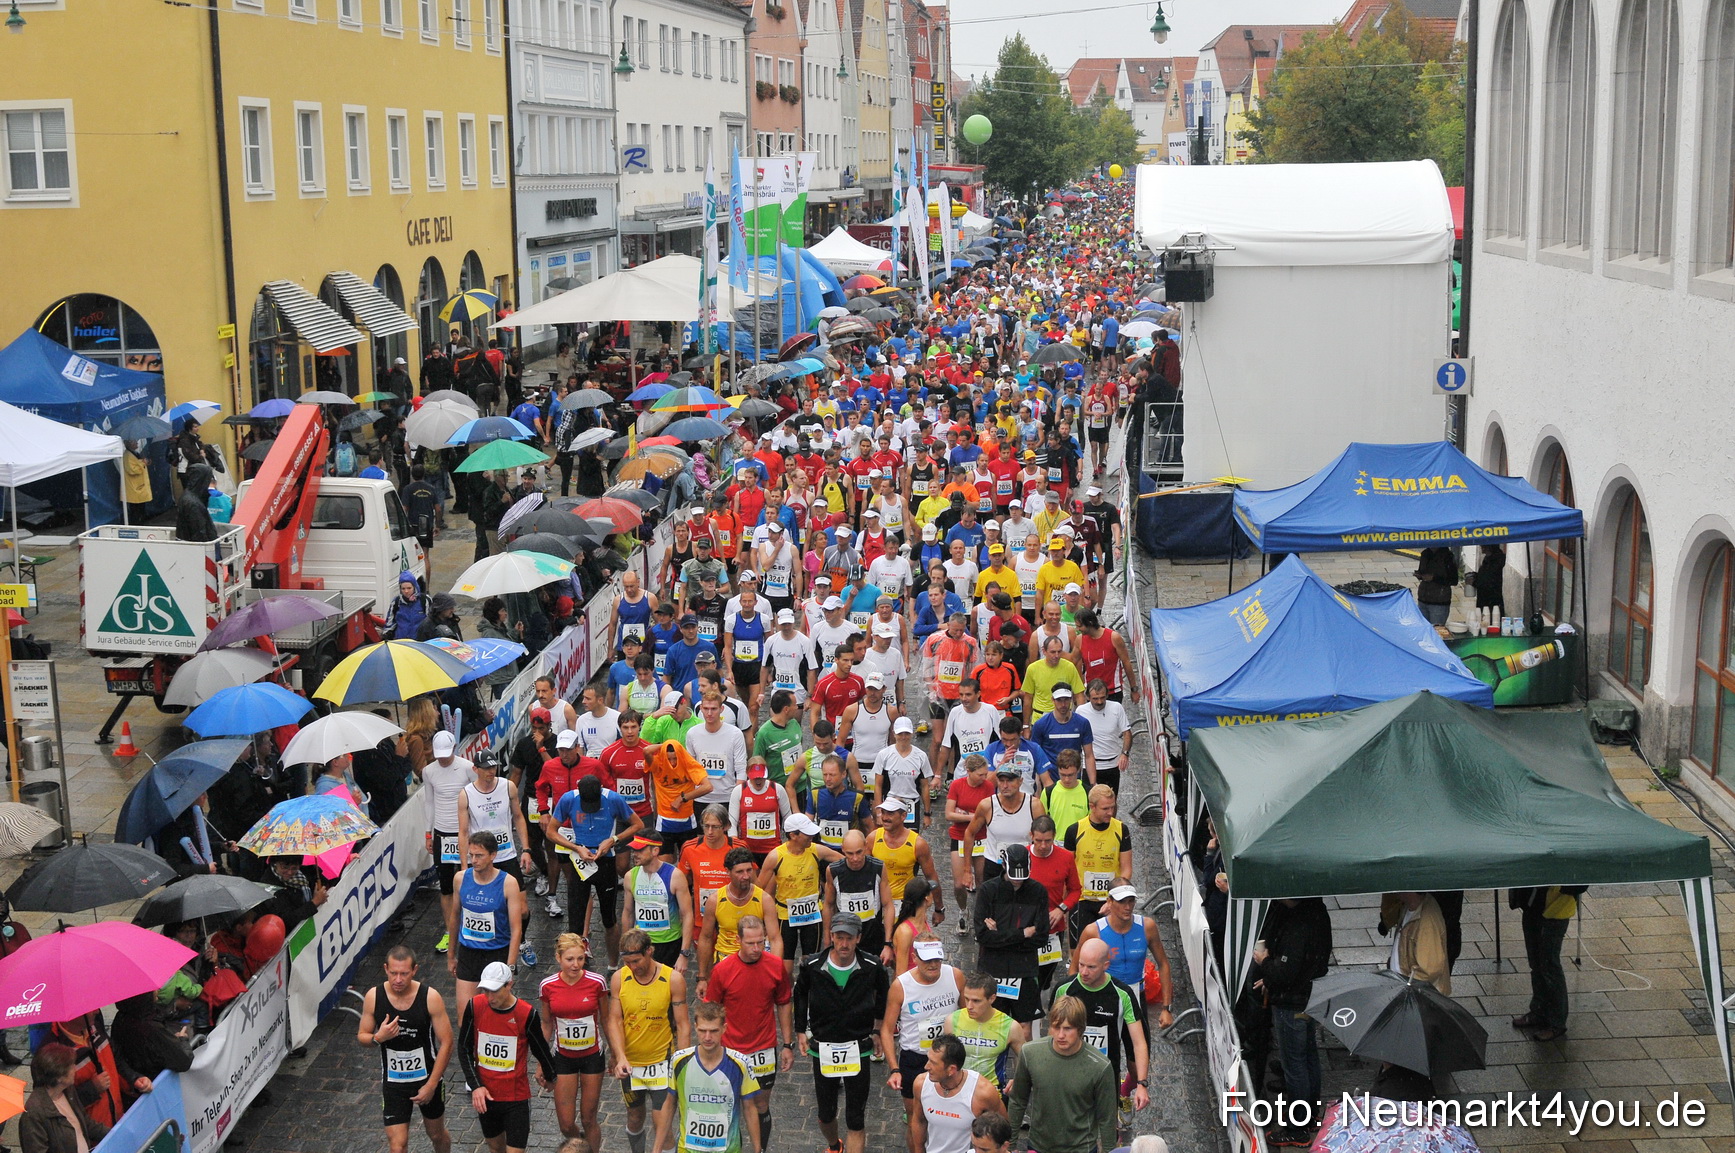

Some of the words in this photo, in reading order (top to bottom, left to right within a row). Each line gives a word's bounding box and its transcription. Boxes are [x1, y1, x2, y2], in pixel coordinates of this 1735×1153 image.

[932, 84, 945, 149] HOTEL
[407, 217, 431, 246] CAFE
[434, 216, 453, 243] DELI
[79, 311, 104, 328] FOTO
[100, 392, 129, 411] Neumarkter
[128, 387, 149, 401] Tagblatt
[1371, 474, 1468, 492] EMMA
[1341, 526, 1509, 543] www.emmanet.com
[768, 574, 785, 583] 3247
[884, 586, 896, 594] 152
[97, 635, 112, 644] Jura
[113, 636, 146, 646] Gebäude
[147, 637, 173, 648] Service
[174, 639, 197, 648] GmbH
[741, 646, 752, 654] 45
[943, 666, 959, 675] 202
[961, 728, 984, 736] Xplus1
[962, 741, 985, 753] 3251
[700, 758, 725, 770] 3419
[892, 769, 915, 777] Xplus1
[619, 784, 643, 795] 2029
[753, 819, 771, 829] 109
[824, 827, 843, 837] 814
[466, 894, 494, 903] ELOTEC
[318, 841, 399, 984] BOCK
[791, 901, 817, 916] 2002
[848, 900, 870, 912] 818
[638, 908, 665, 921] 2001
[465, 917, 492, 932] 3225
[241, 960, 283, 1035] Xplus1
[922, 997, 956, 1013] MECKLER
[565, 1026, 588, 1039] 187
[484, 1043, 509, 1059] 605
[832, 1050, 848, 1064] 57
[390, 1056, 423, 1072] 3122
[191, 1117, 205, 1137] Ihr
[258, 1010, 285, 1050] Neumarkt
[690, 1086, 716, 1094] TEAM
[688, 1094, 727, 1104] BOCK
[690, 1120, 725, 1138] 2000
[695, 1138, 717, 1147] Michael
